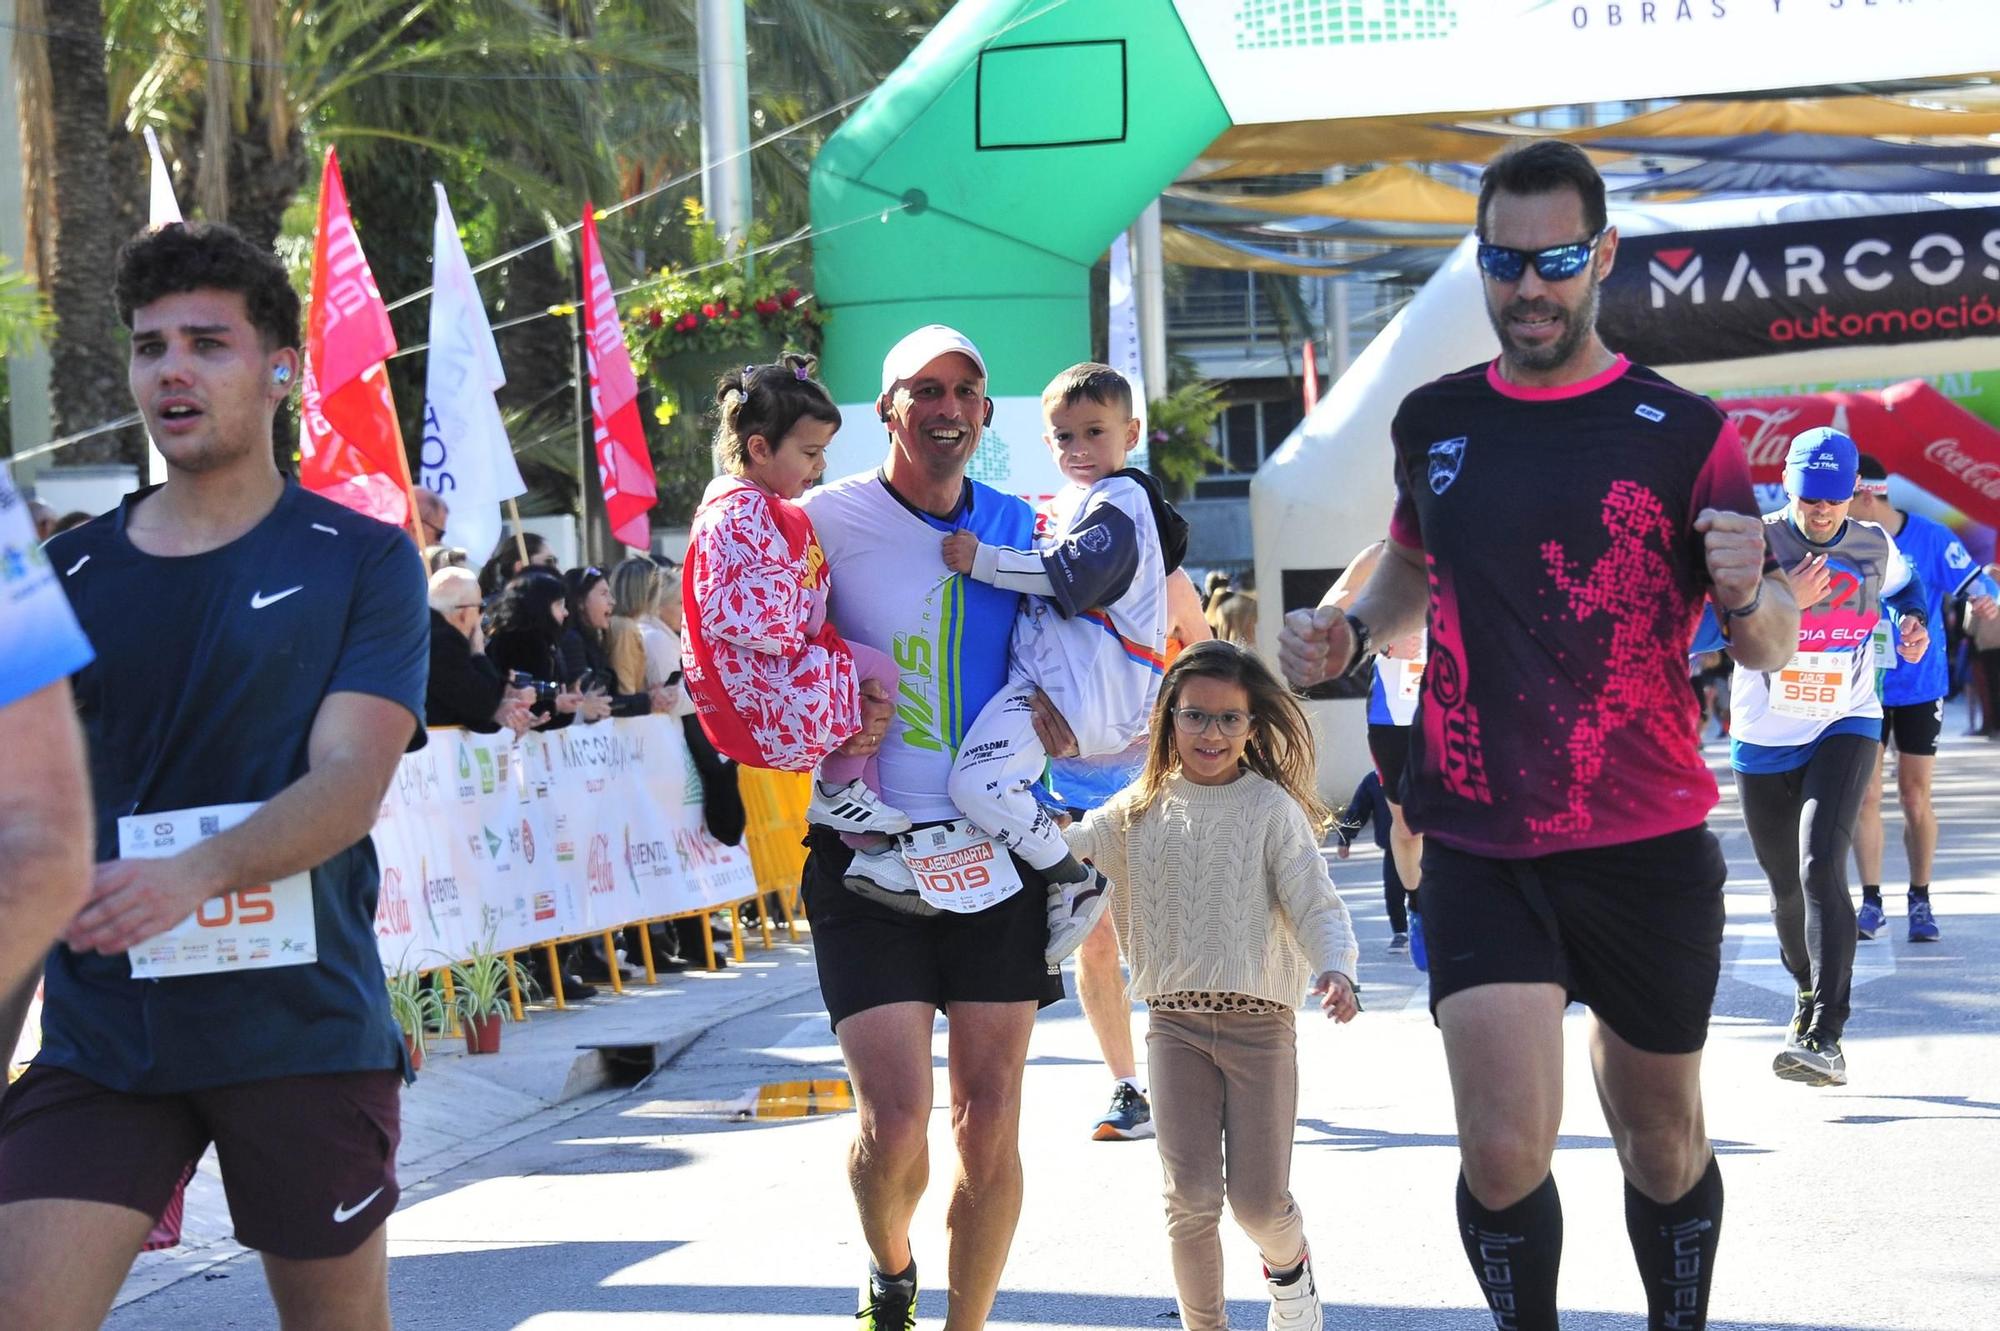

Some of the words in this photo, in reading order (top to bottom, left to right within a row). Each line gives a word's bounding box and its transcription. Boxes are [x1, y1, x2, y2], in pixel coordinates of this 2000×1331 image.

[1572, 0, 1726, 28] OBRAS
[1769, 294, 2000, 341] automoció
[1831, 628, 1869, 640] ELC
[1799, 673, 1826, 685] CARLOS
[1785, 685, 1836, 702] 958
[963, 739, 1010, 759] AWESOME
[917, 866, 990, 893] 1019
[196, 884, 275, 928] 05
